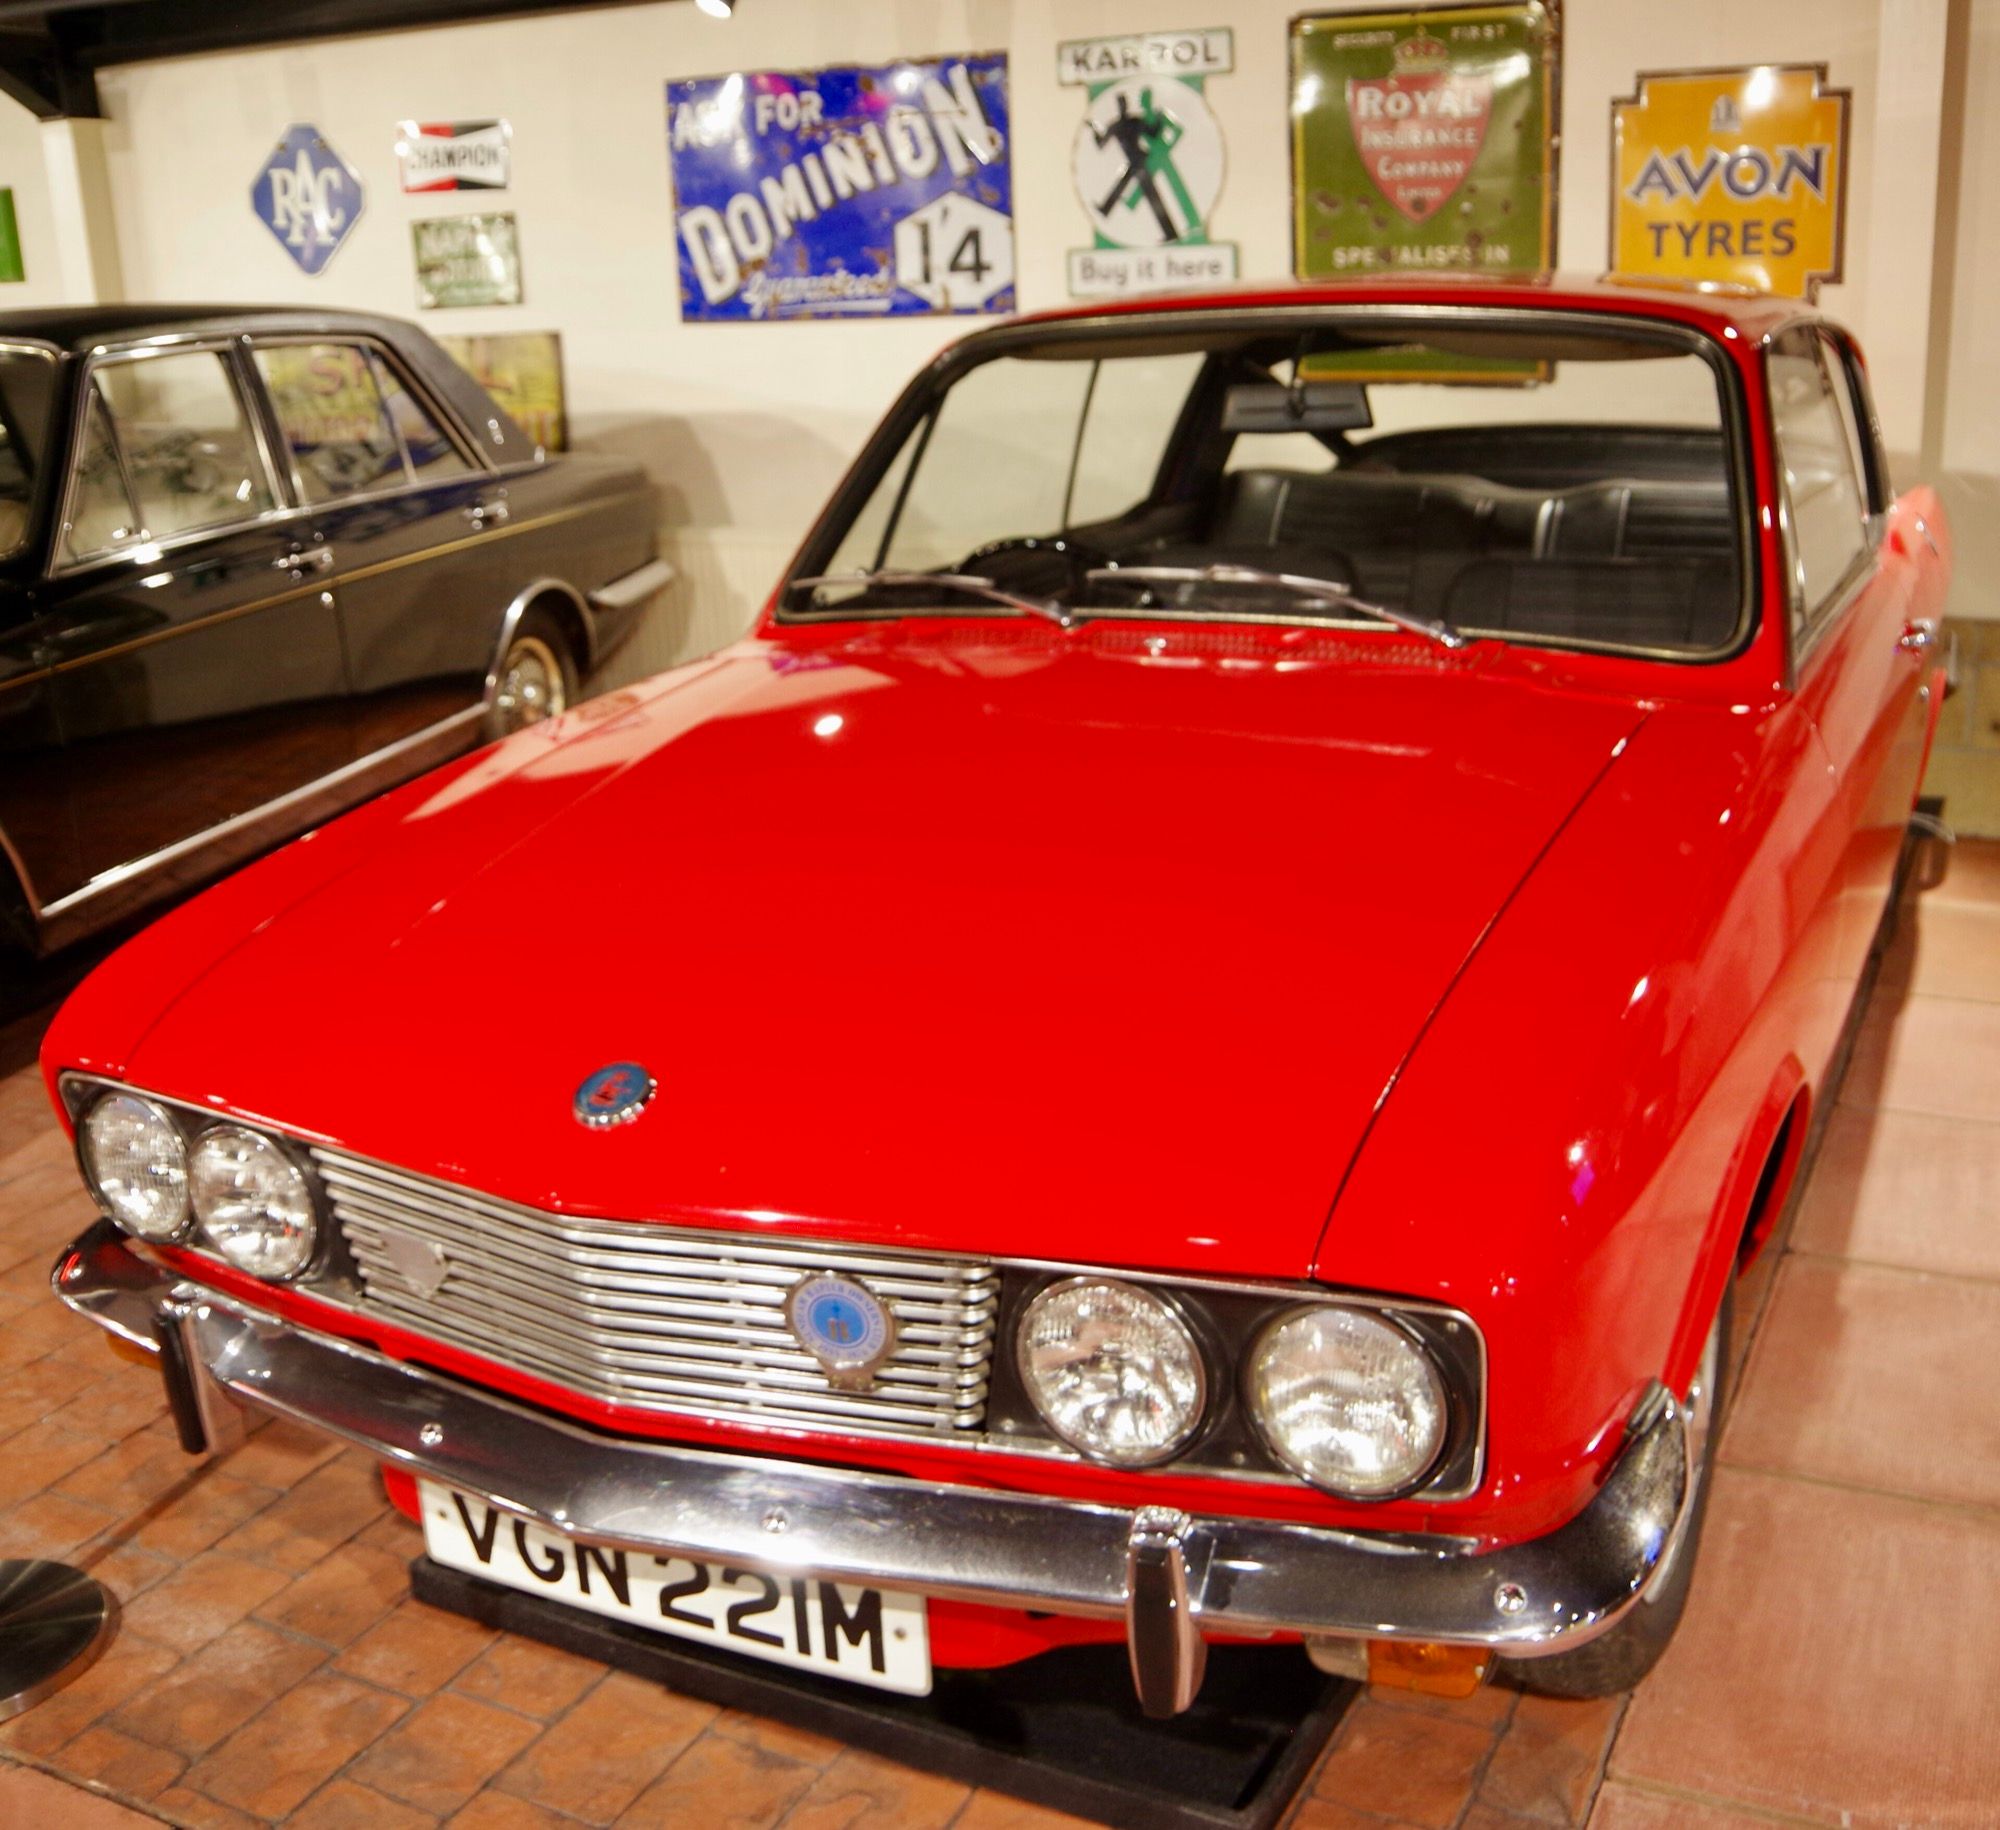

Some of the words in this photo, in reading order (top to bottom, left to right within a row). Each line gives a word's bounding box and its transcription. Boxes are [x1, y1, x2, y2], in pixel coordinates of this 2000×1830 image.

[755, 90, 825, 141] FOR
[1355, 85, 1482, 121] ROYAL
[267, 148, 346, 246] RAC
[679, 63, 1004, 305] DOMINION
[1627, 144, 1829, 202] AVON
[1485, 244, 1511, 264] IN
[1647, 218, 1798, 259] TYRES
[1080, 256, 1128, 287] Buy
[1137, 257, 1154, 279] it
[1166, 254, 1221, 278] here
[452, 1490, 631, 1607] VGN
[655, 1556, 886, 1674] 221M
